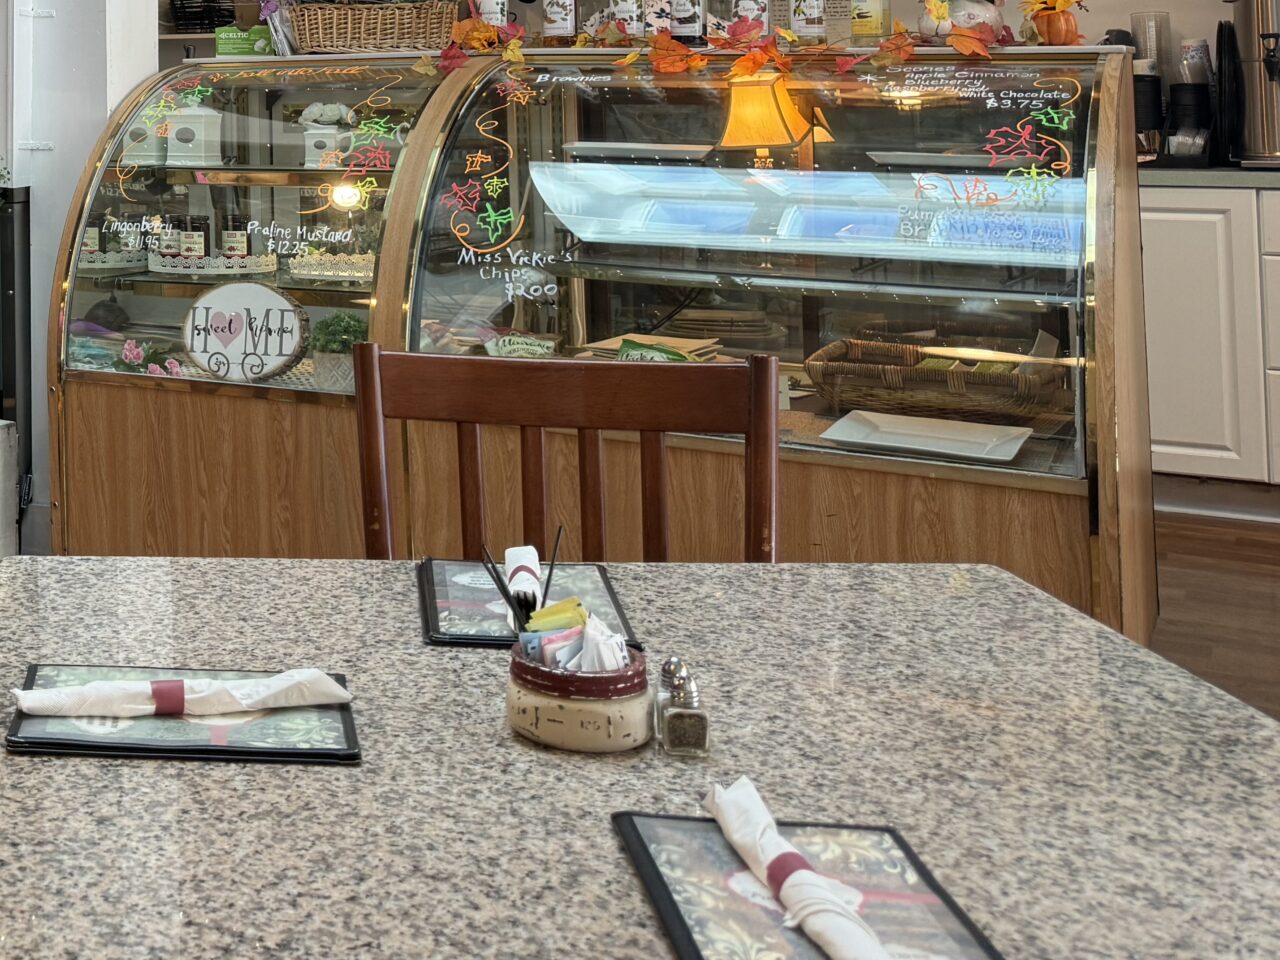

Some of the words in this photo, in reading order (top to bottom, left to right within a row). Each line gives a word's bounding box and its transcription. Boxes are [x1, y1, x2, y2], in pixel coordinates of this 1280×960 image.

[534, 74, 612, 84] Brownies
[905, 72, 946, 80] Apple
[904, 79, 983, 88] Blueberry
[1000, 90, 1072, 99] Chocolate
[985, 97, 1045, 109] $3.75
[101, 215, 174, 239] Lingonberry
[247, 220, 292, 241] Praline
[128, 235, 159, 249] $11.95
[267, 239, 310, 255] $12.25
[457, 247, 502, 265] Miss
[506, 246, 573, 268] Vickie's
[480, 265, 530, 283] Chips
